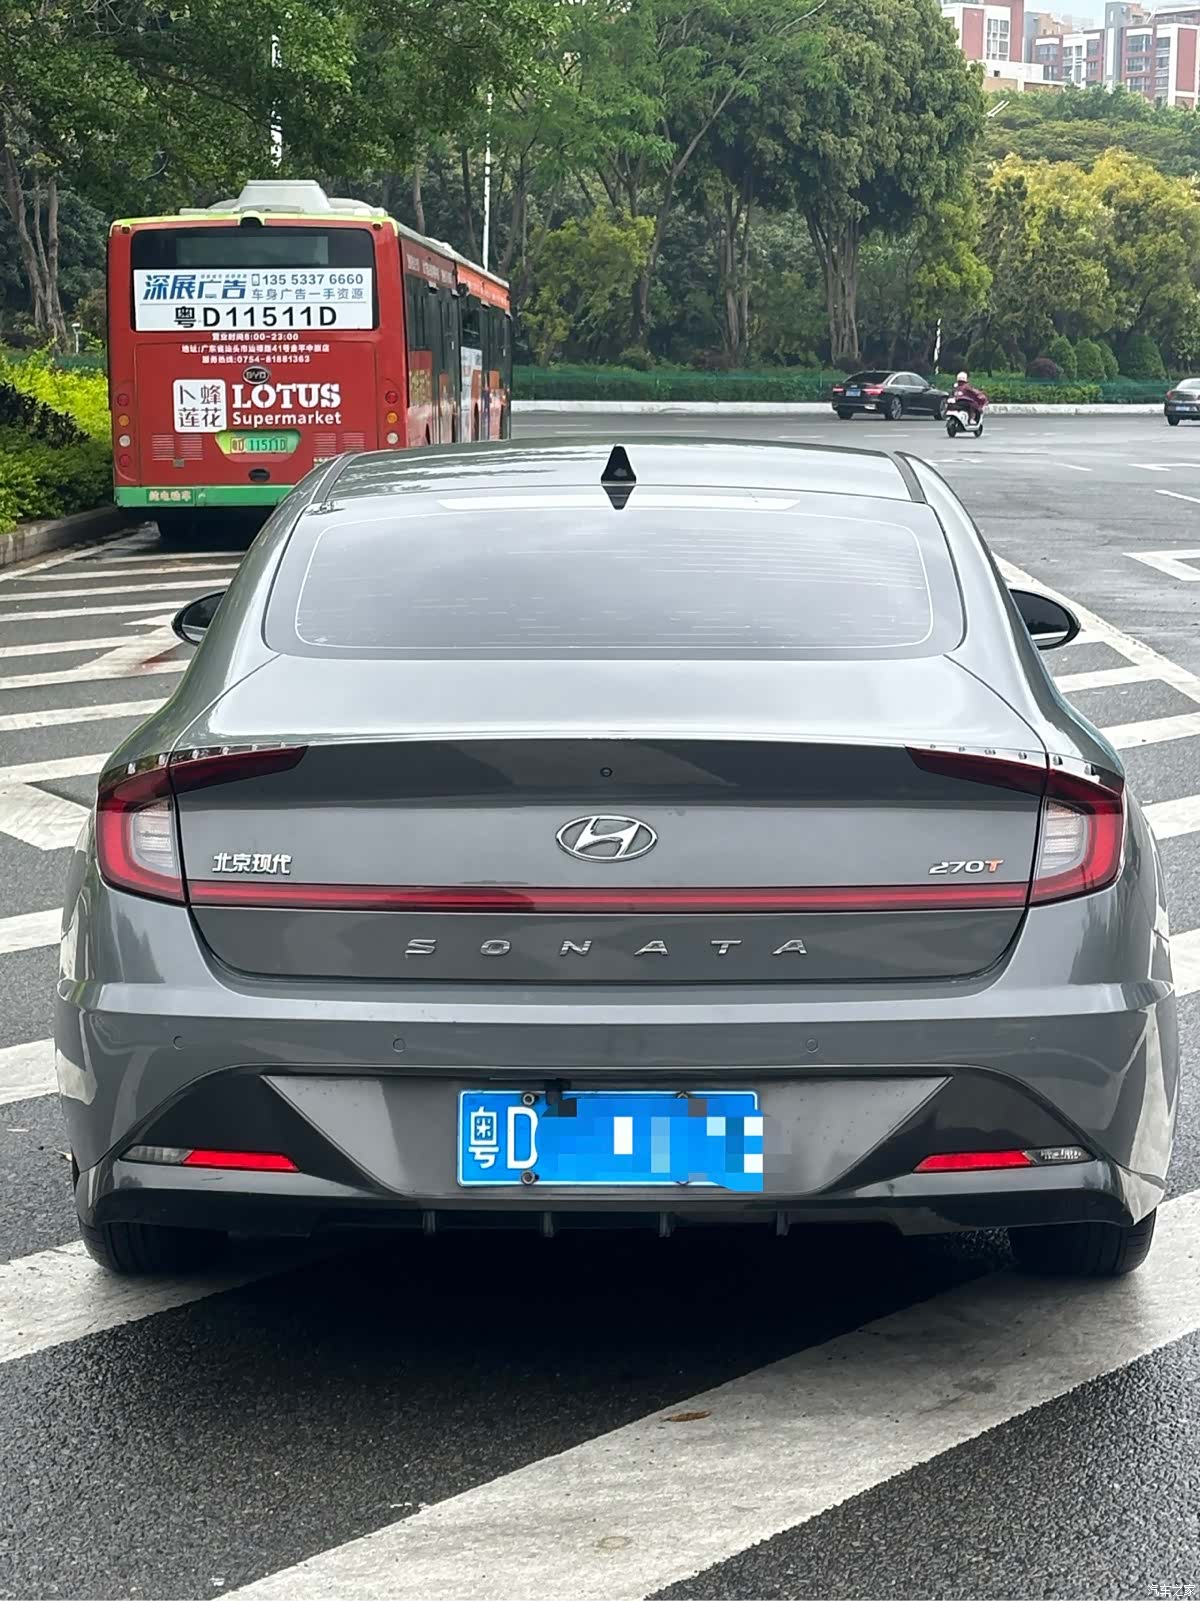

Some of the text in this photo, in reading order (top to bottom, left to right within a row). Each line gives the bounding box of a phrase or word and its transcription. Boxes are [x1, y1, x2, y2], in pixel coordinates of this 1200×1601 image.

[143, 274, 247, 300] 深展广告
[262, 273, 364, 286] 135 5337 6660
[251, 287, 364, 301] 车身广告一手资源
[179, 384, 222, 405] 卜蜂
[231, 383, 342, 409] LOTUS
[178, 407, 222, 428] 莲花
[232, 411, 342, 428] Supermarket
[211, 852, 292, 875] 北京现代
[928, 859, 1004, 875] 270T
[404, 937, 809, 957] SONATA
